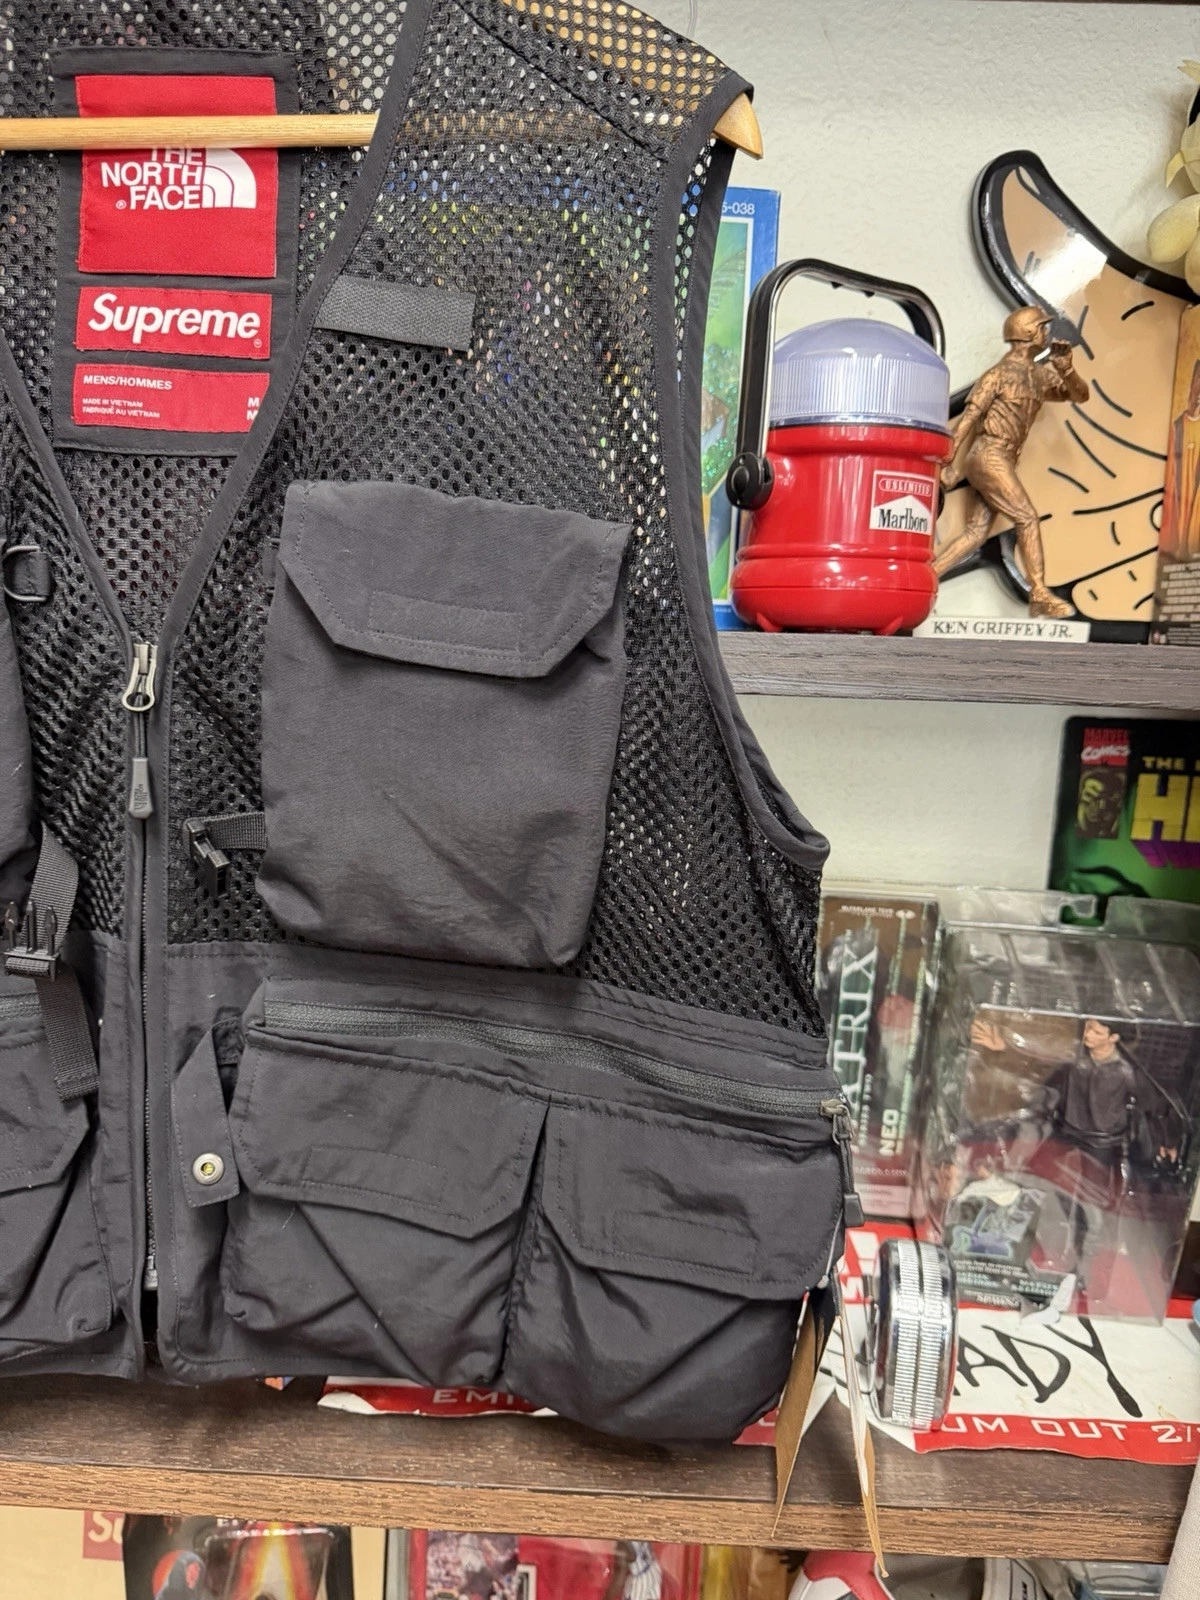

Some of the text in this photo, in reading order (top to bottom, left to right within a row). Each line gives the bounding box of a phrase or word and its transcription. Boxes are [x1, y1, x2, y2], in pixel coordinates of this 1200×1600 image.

[101, 161, 201, 187] NORTH
[130, 185, 201, 210] FACE
[88, 293, 260, 344] Supreme
[83, 375, 172, 390] MENS/HOMMES
[110, 399, 143, 408] VIETNAM
[248, 397, 260, 407] M
[127, 409, 160, 418] VIETNAM
[878, 508, 928, 533] Marlboro
[933, 621, 1073, 638] KEN GRIFFEY JR.
[1142, 756, 1185, 770] THE
[879, 1109, 899, 1156] NEO
[1031, 1419, 1127, 1440] OUT
